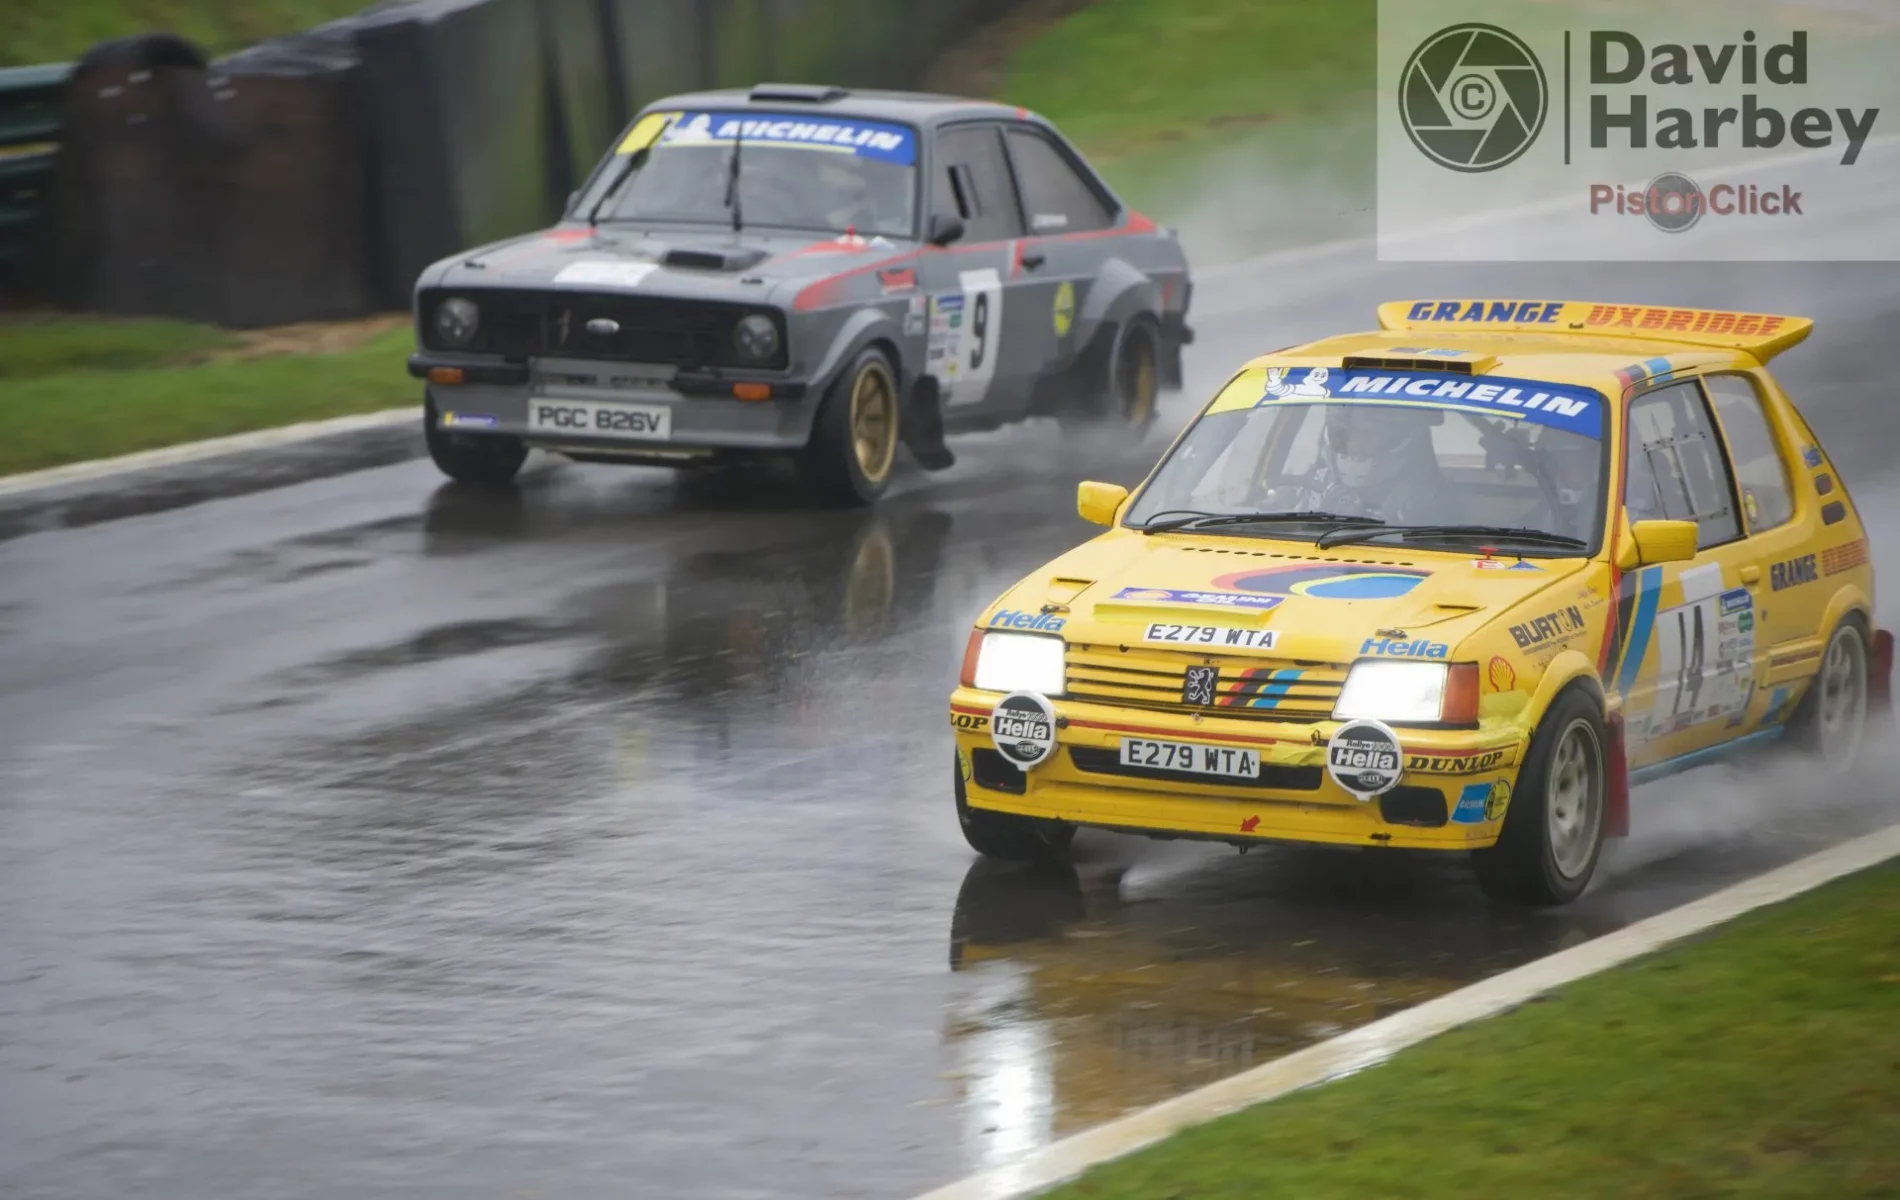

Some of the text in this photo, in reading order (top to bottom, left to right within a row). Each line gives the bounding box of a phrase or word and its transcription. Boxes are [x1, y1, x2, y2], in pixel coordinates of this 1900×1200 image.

[717, 120, 904, 151] MICHELIN
[970, 291, 988, 370] 9
[1406, 301, 1786, 336] GRANGE UXBRIDGE
[1338, 375, 1589, 417] MICHELIN
[538, 406, 662, 432] PGC 826V
[989, 609, 1066, 631] Hella
[1508, 605, 1585, 649] BURTON
[1147, 623, 1274, 648] E279 WTA
[1359, 638, 1449, 658] Hella
[1672, 604, 1704, 715] 14
[997, 717, 1047, 739] Hella
[1128, 738, 1251, 776] E279 WTA
[1335, 748, 1394, 769] Hella
[1406, 751, 1503, 771] DUNLOP
